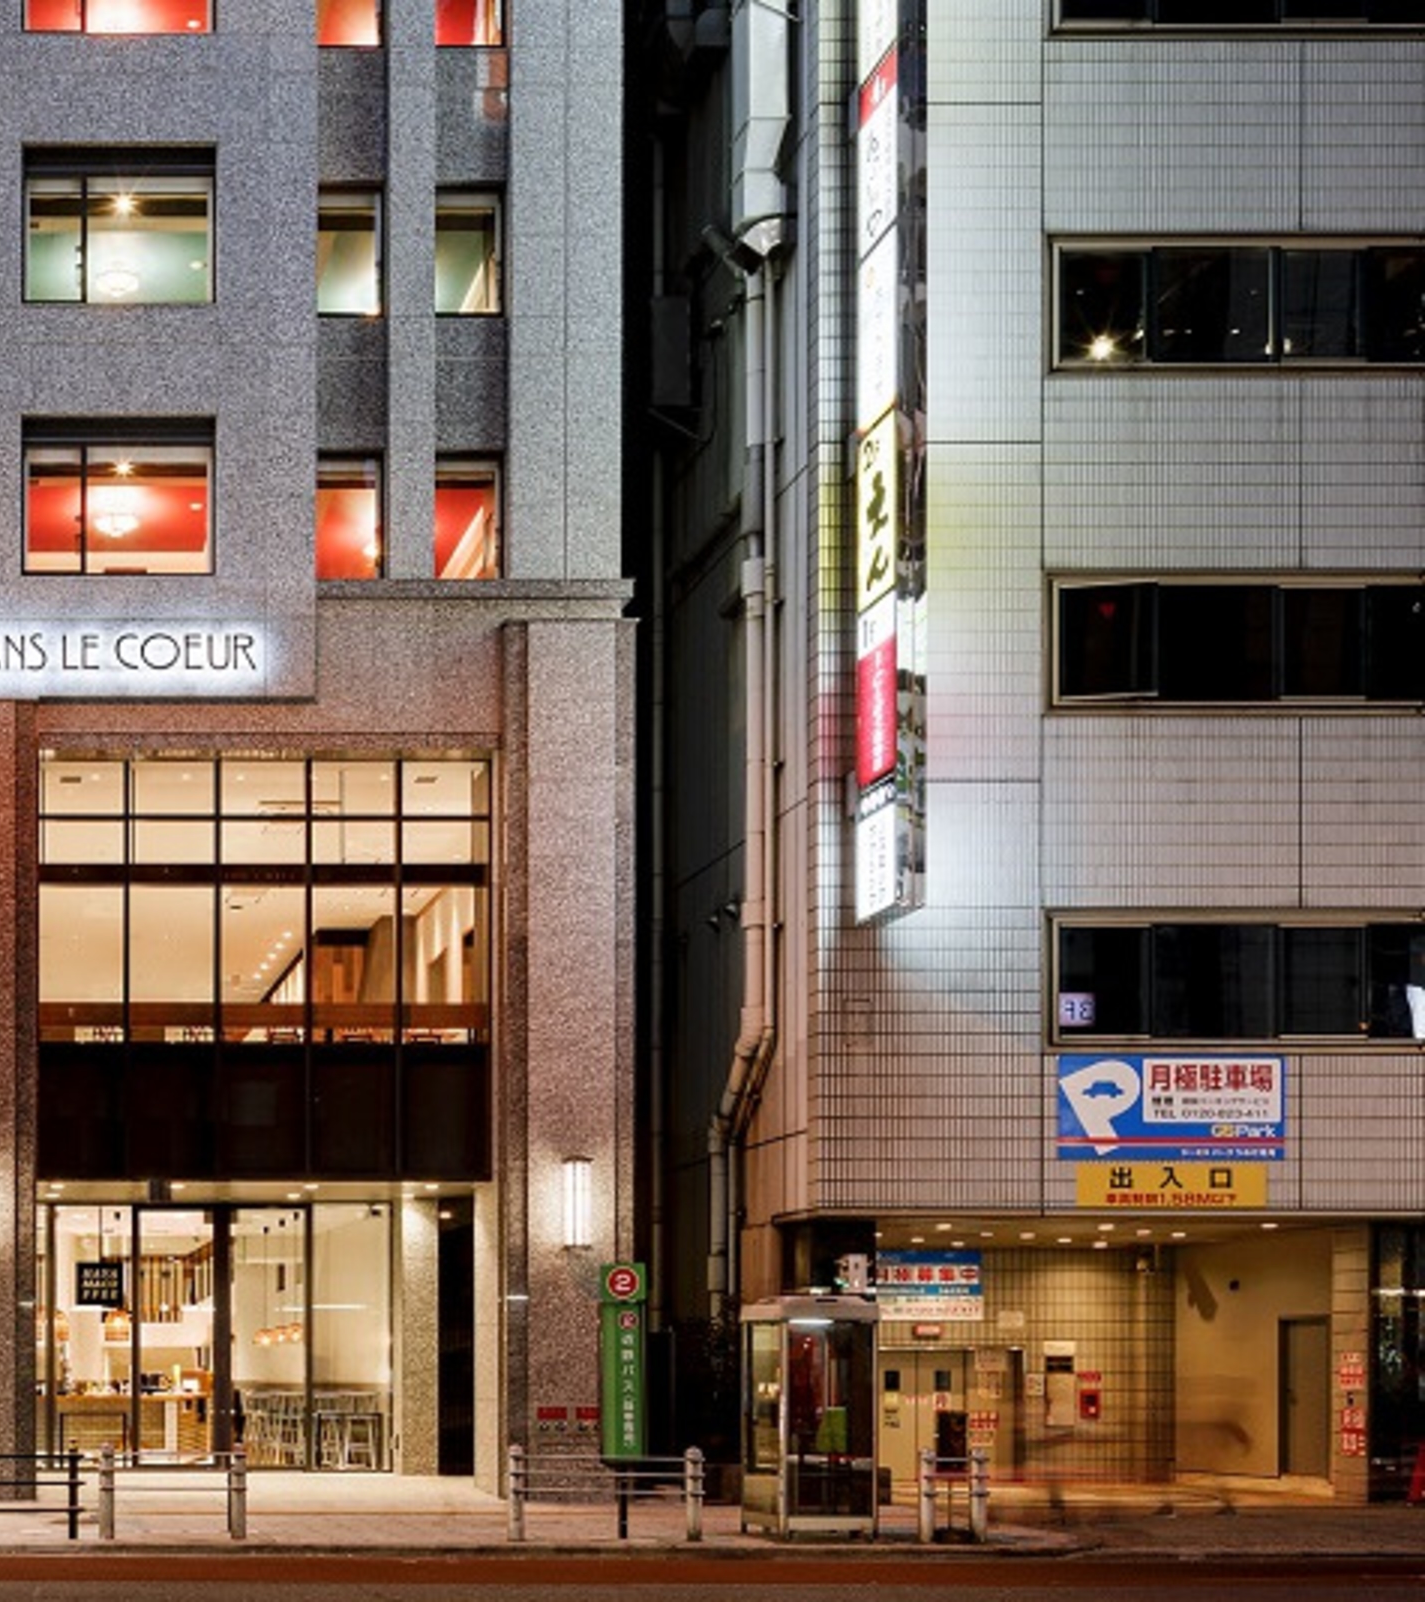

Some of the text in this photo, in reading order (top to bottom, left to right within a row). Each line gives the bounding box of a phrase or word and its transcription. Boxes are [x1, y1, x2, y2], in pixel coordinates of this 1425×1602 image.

[63, 634, 101, 671] LE
[114, 633, 258, 671] COEUR
[1150, 1064, 1273, 1092] 月極駐車場
[1154, 1110, 1175, 1118] TEL
[1109, 1167, 1233, 1189] 出入口
[615, 1275, 631, 1291] 2
